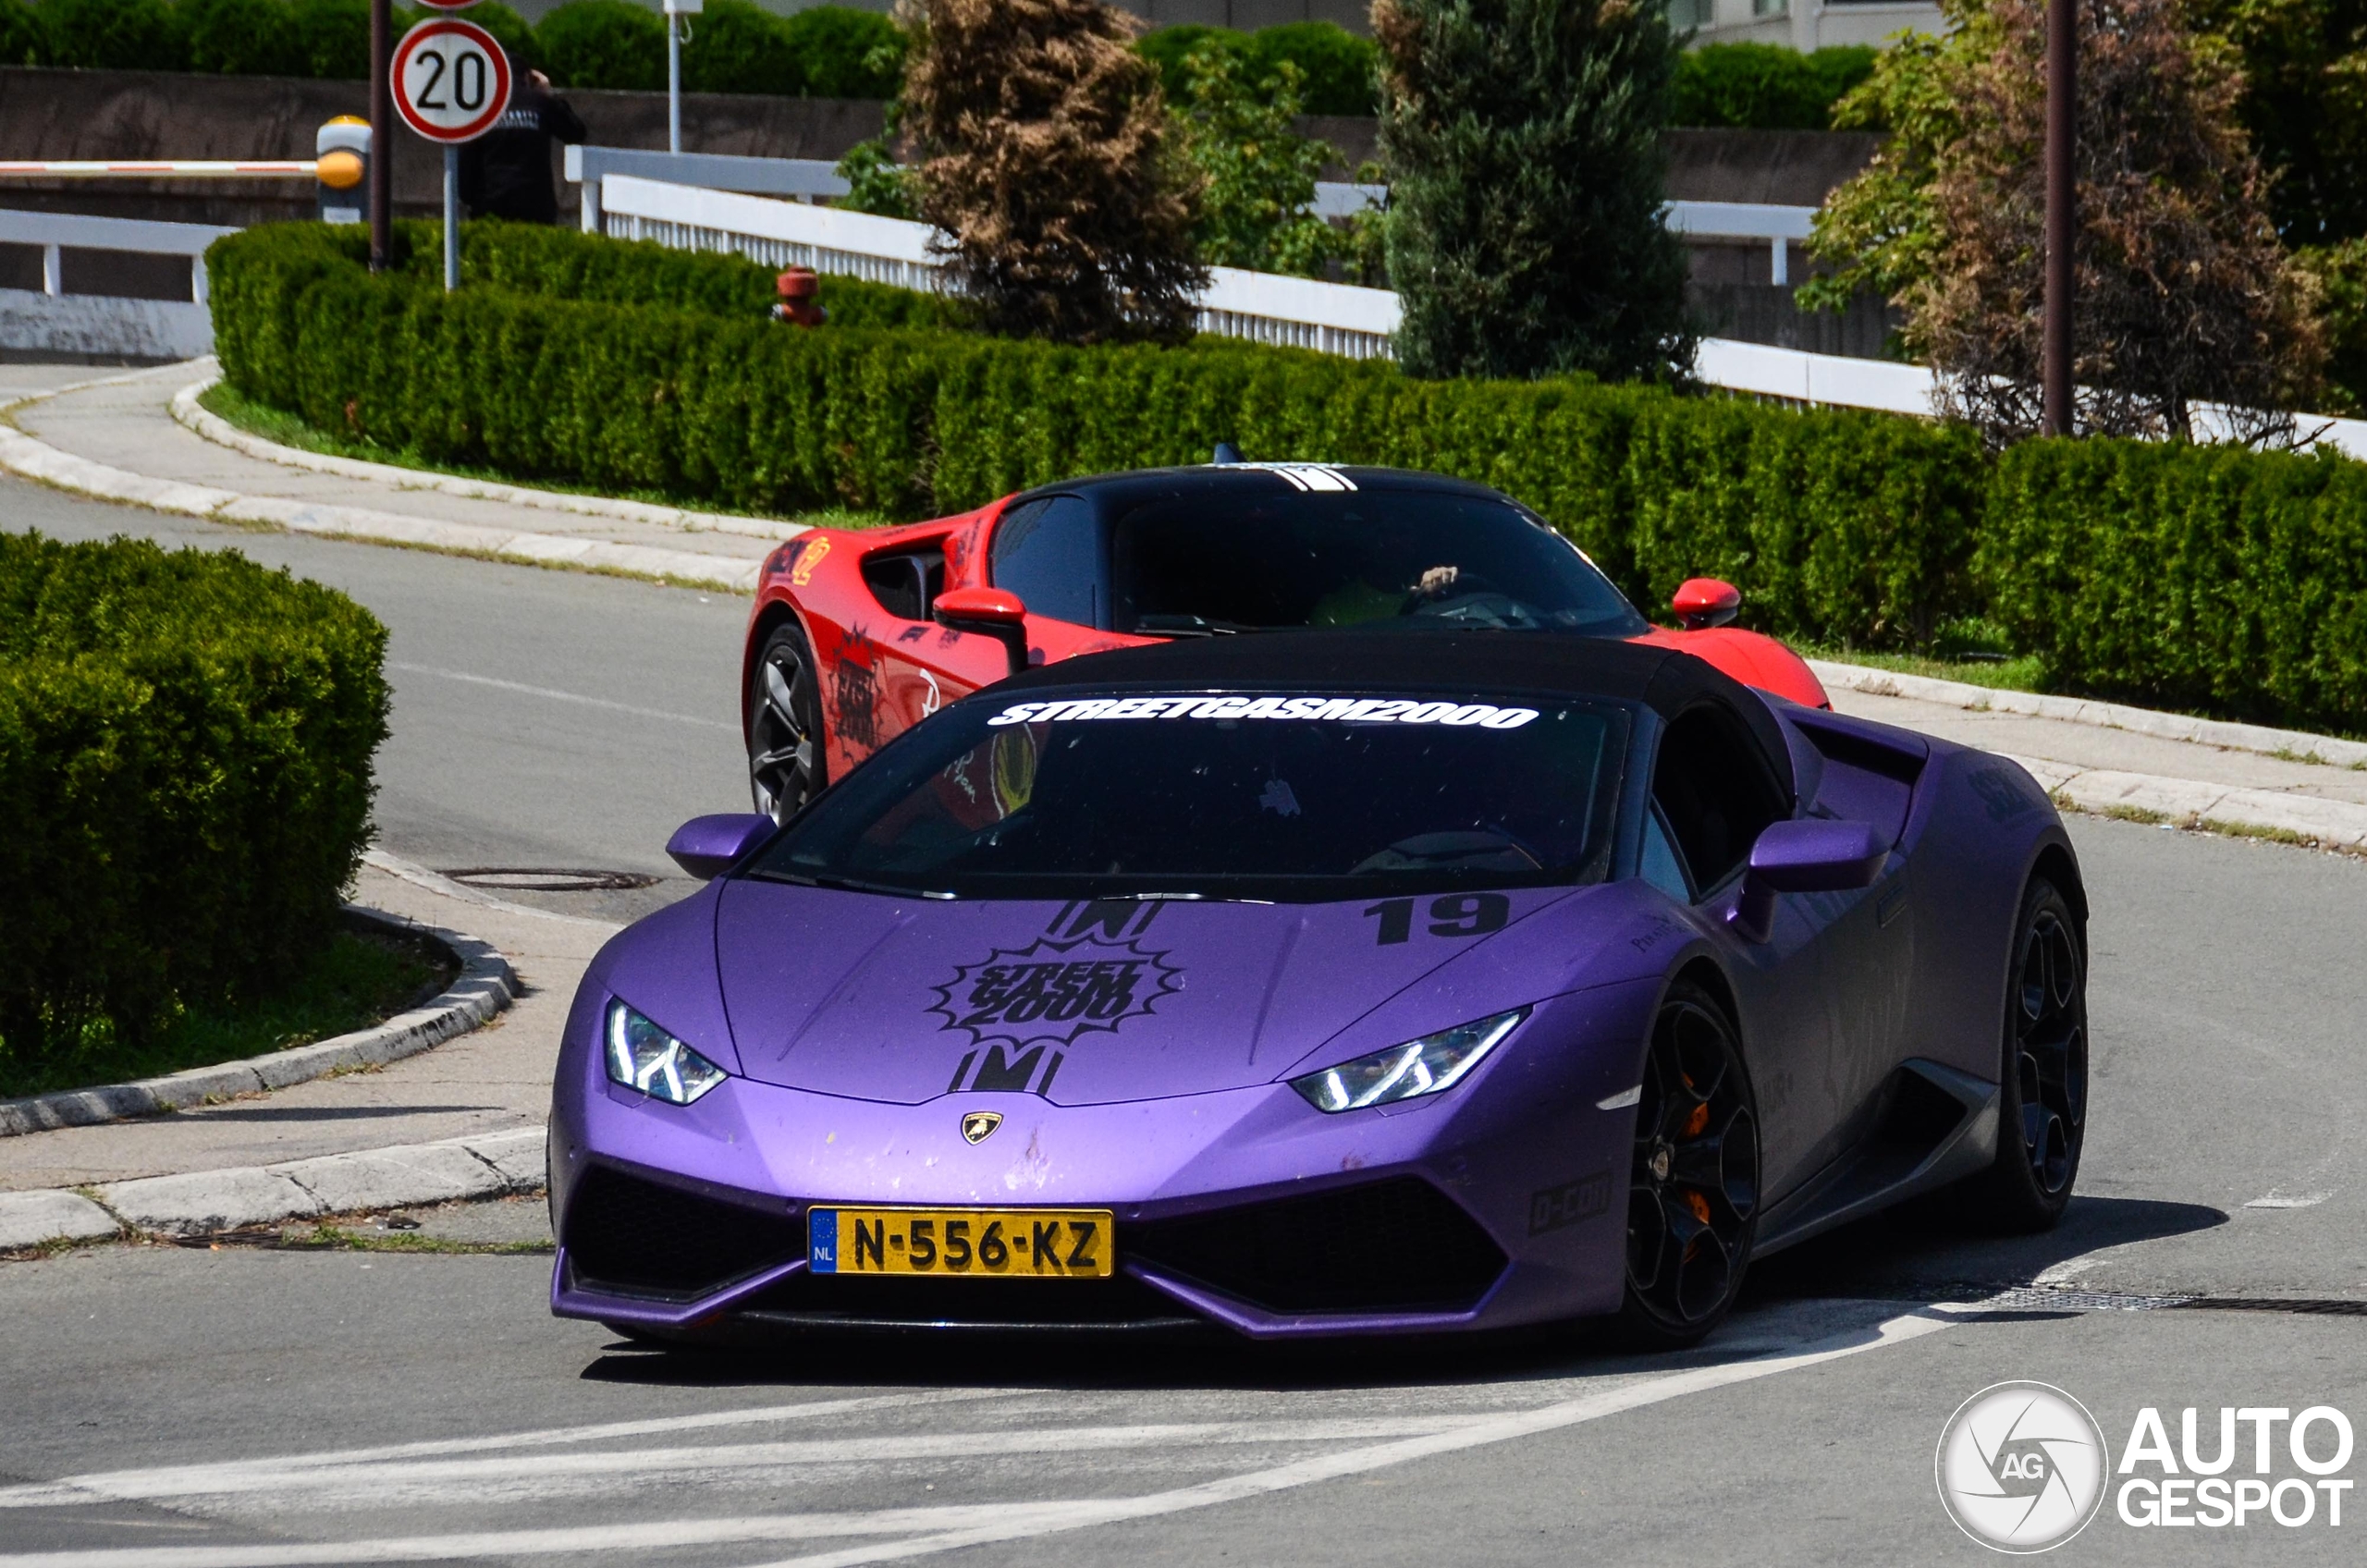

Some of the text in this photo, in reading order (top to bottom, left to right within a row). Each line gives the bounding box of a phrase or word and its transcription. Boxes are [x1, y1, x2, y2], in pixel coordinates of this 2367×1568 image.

[417, 50, 485, 110] 20
[987, 697, 1539, 729] STREETGASM2000
[1363, 892, 1510, 946] 19
[975, 959, 1149, 984] STREET
[956, 991, 1134, 1025] 2000
[968, 974, 1142, 1009] GASM
[815, 1246, 832, 1261] NL
[855, 1219, 1097, 1267] N-556-KZ
